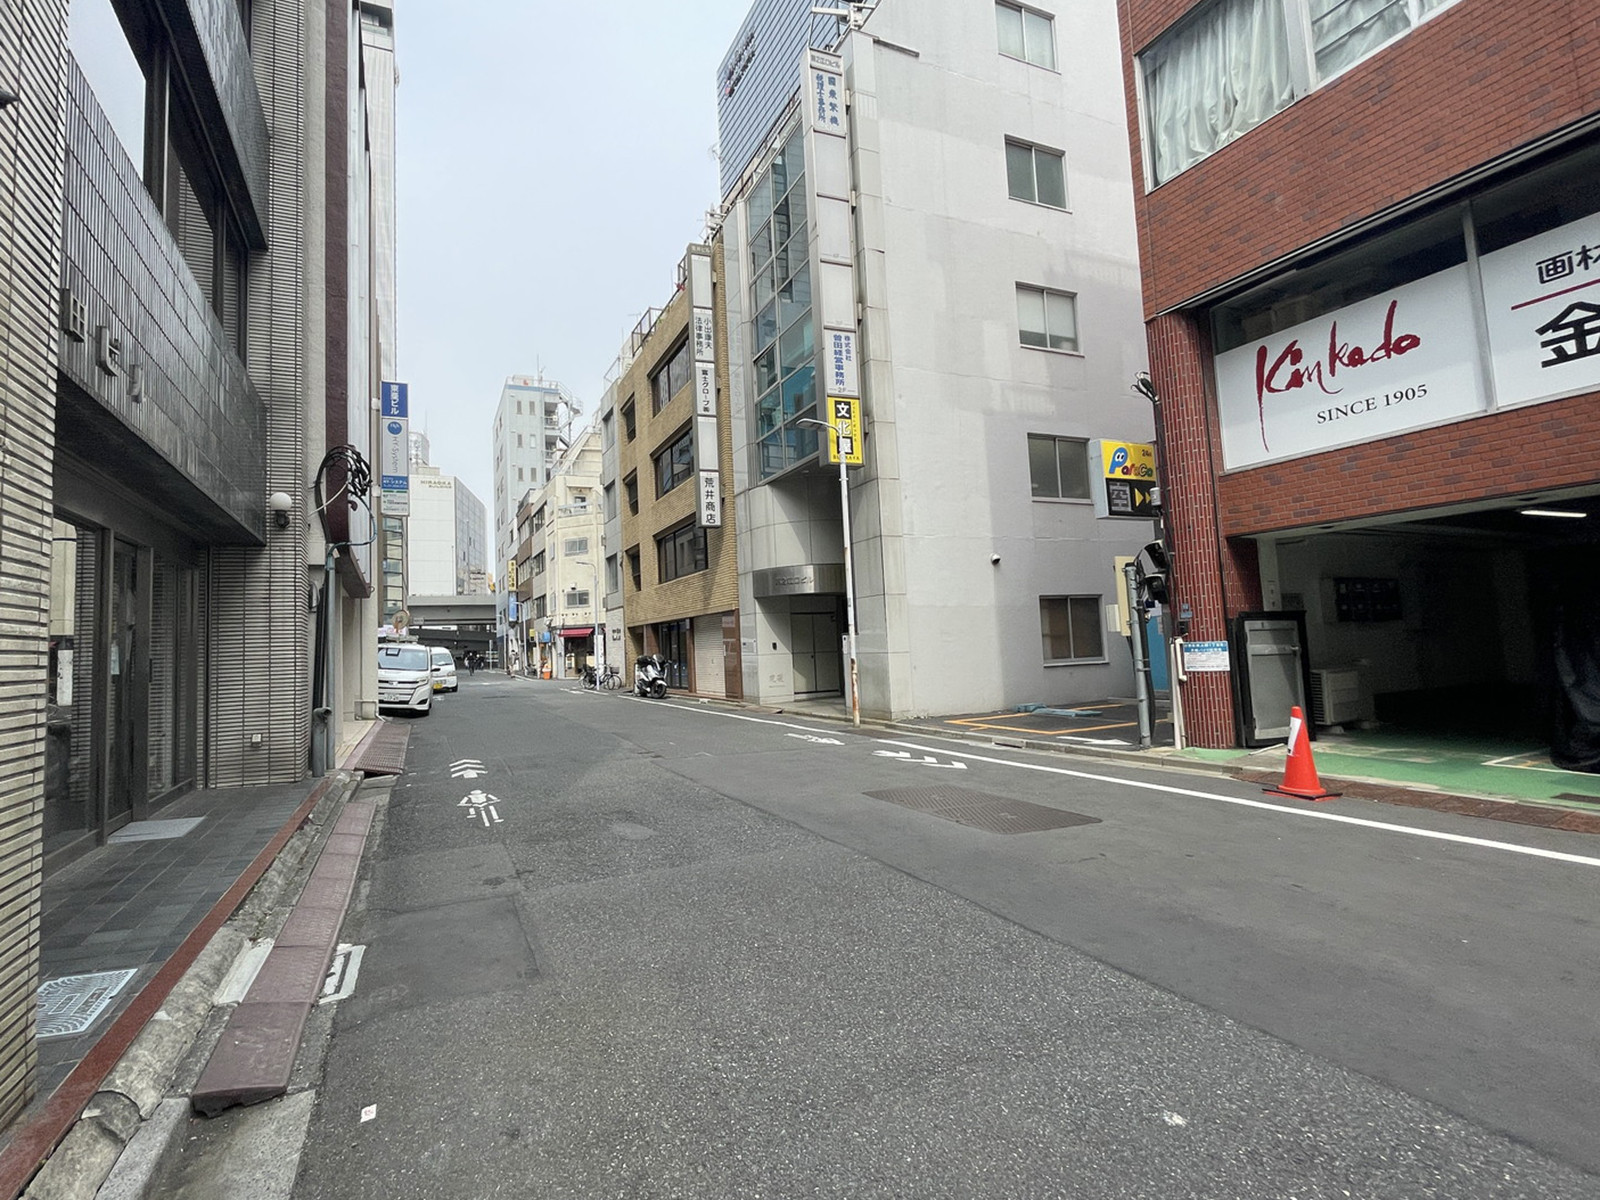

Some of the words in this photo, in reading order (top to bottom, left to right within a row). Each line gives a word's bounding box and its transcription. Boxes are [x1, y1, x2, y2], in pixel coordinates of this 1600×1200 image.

[695, 316, 704, 357] 法律事務所
[1256, 299, 1421, 453] Kinkado
[1316, 397, 1378, 425] SINCE
[1384, 384, 1428, 408] 1905
[704, 477, 716, 524] 荒井商店
